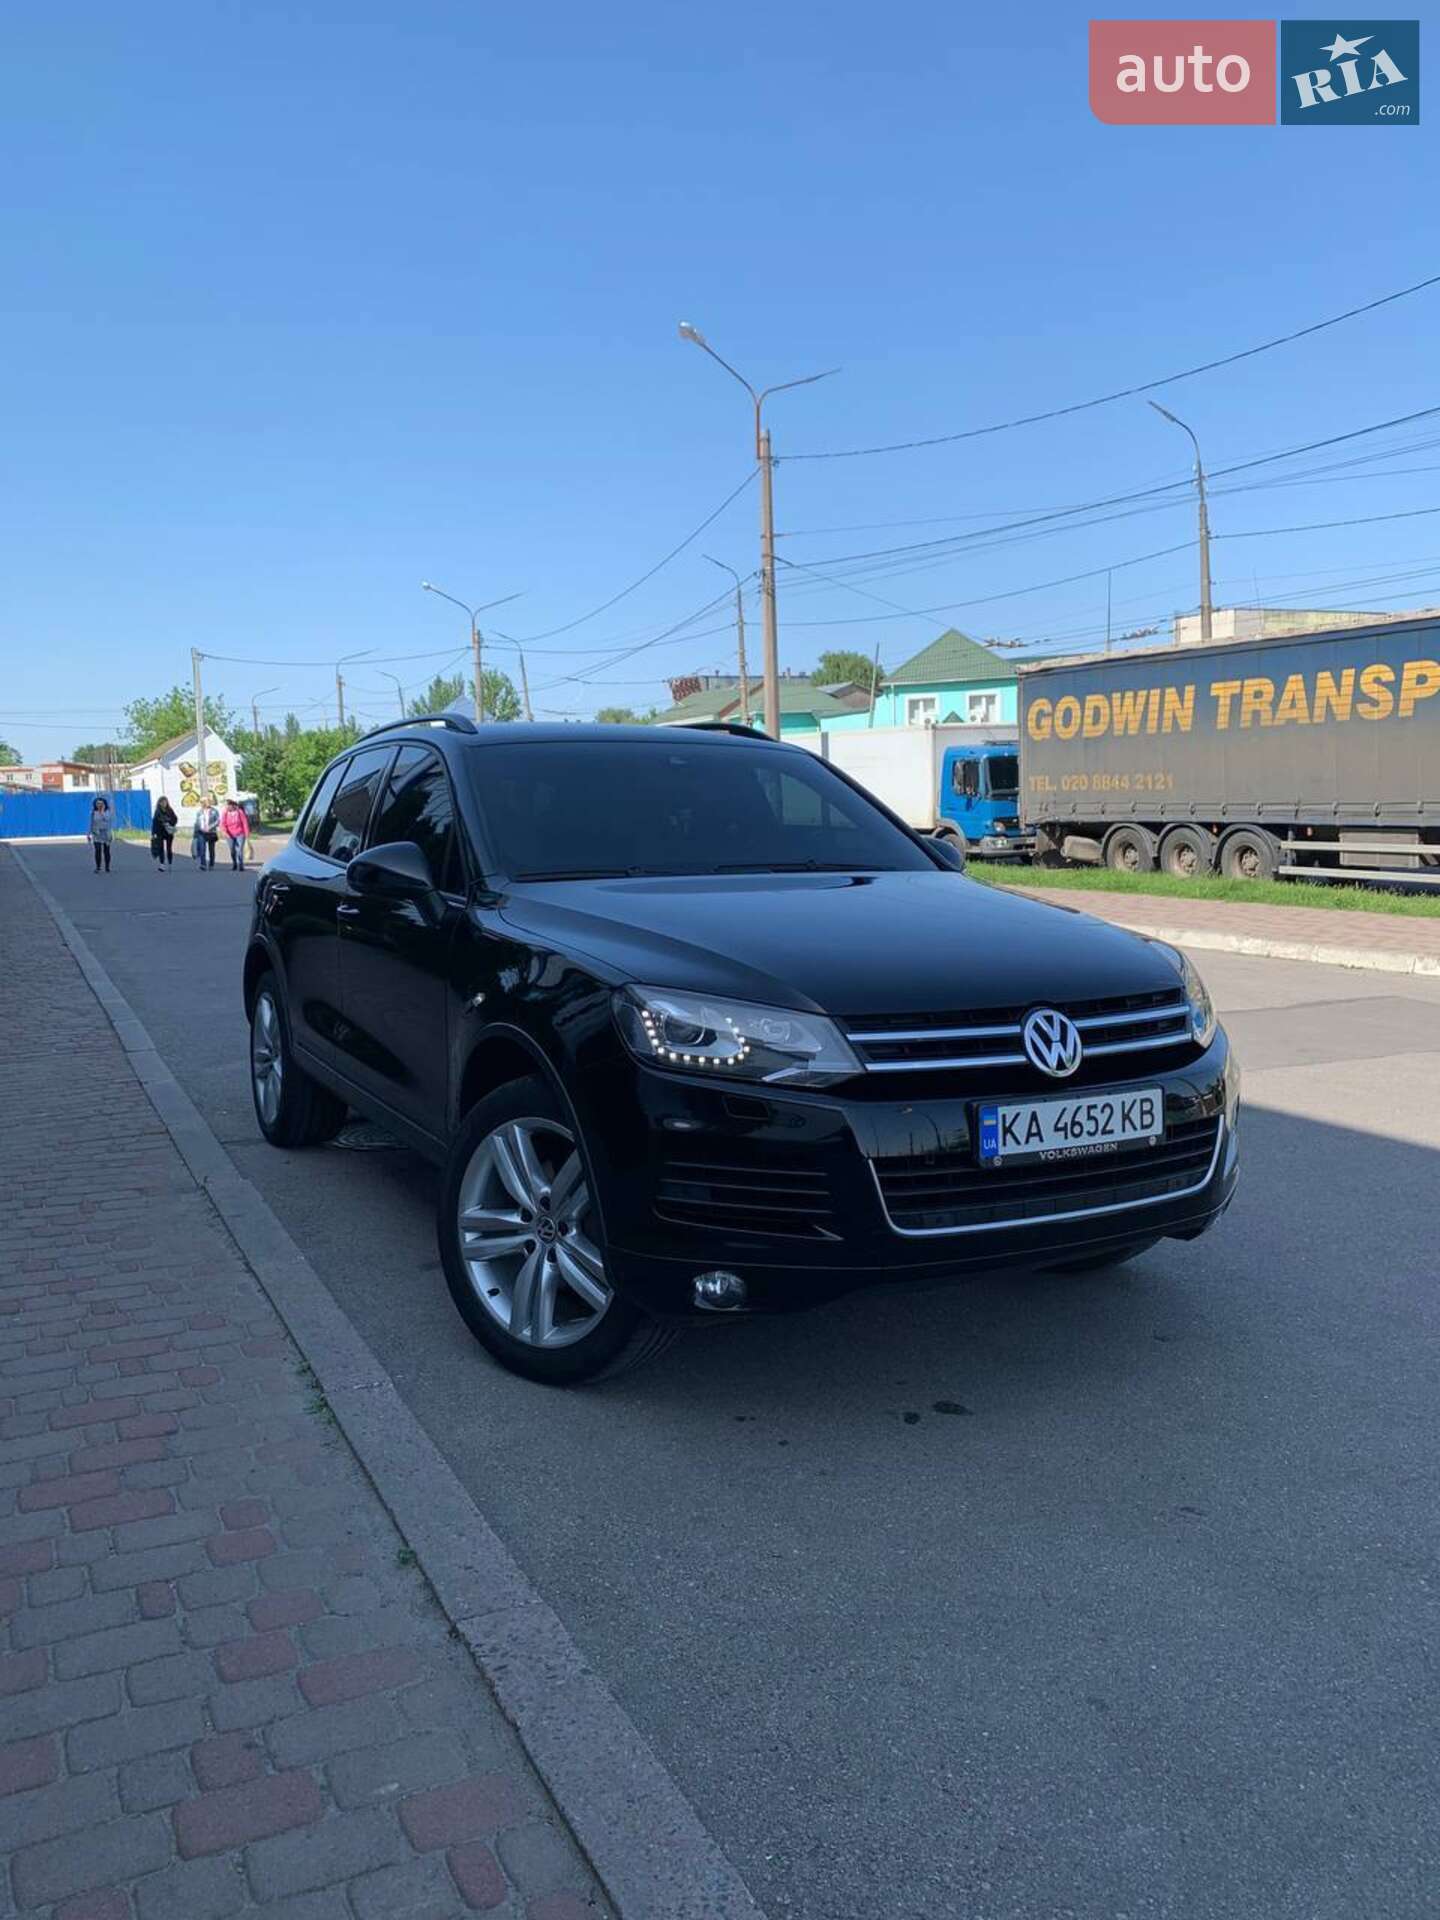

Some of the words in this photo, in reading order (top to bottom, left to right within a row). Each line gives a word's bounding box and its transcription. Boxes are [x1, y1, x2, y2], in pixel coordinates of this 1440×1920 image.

[1027, 684, 1195, 741] GODWIN
[1210, 660, 1440, 730] TRANSP
[1029, 775, 1056, 792] TEL.
[1002, 1110, 1044, 1147] KA
[1053, 1102, 1115, 1140] 4652
[1121, 1097, 1155, 1133] KB
[1039, 1142, 1118, 1160] VOLKSWAGEN
